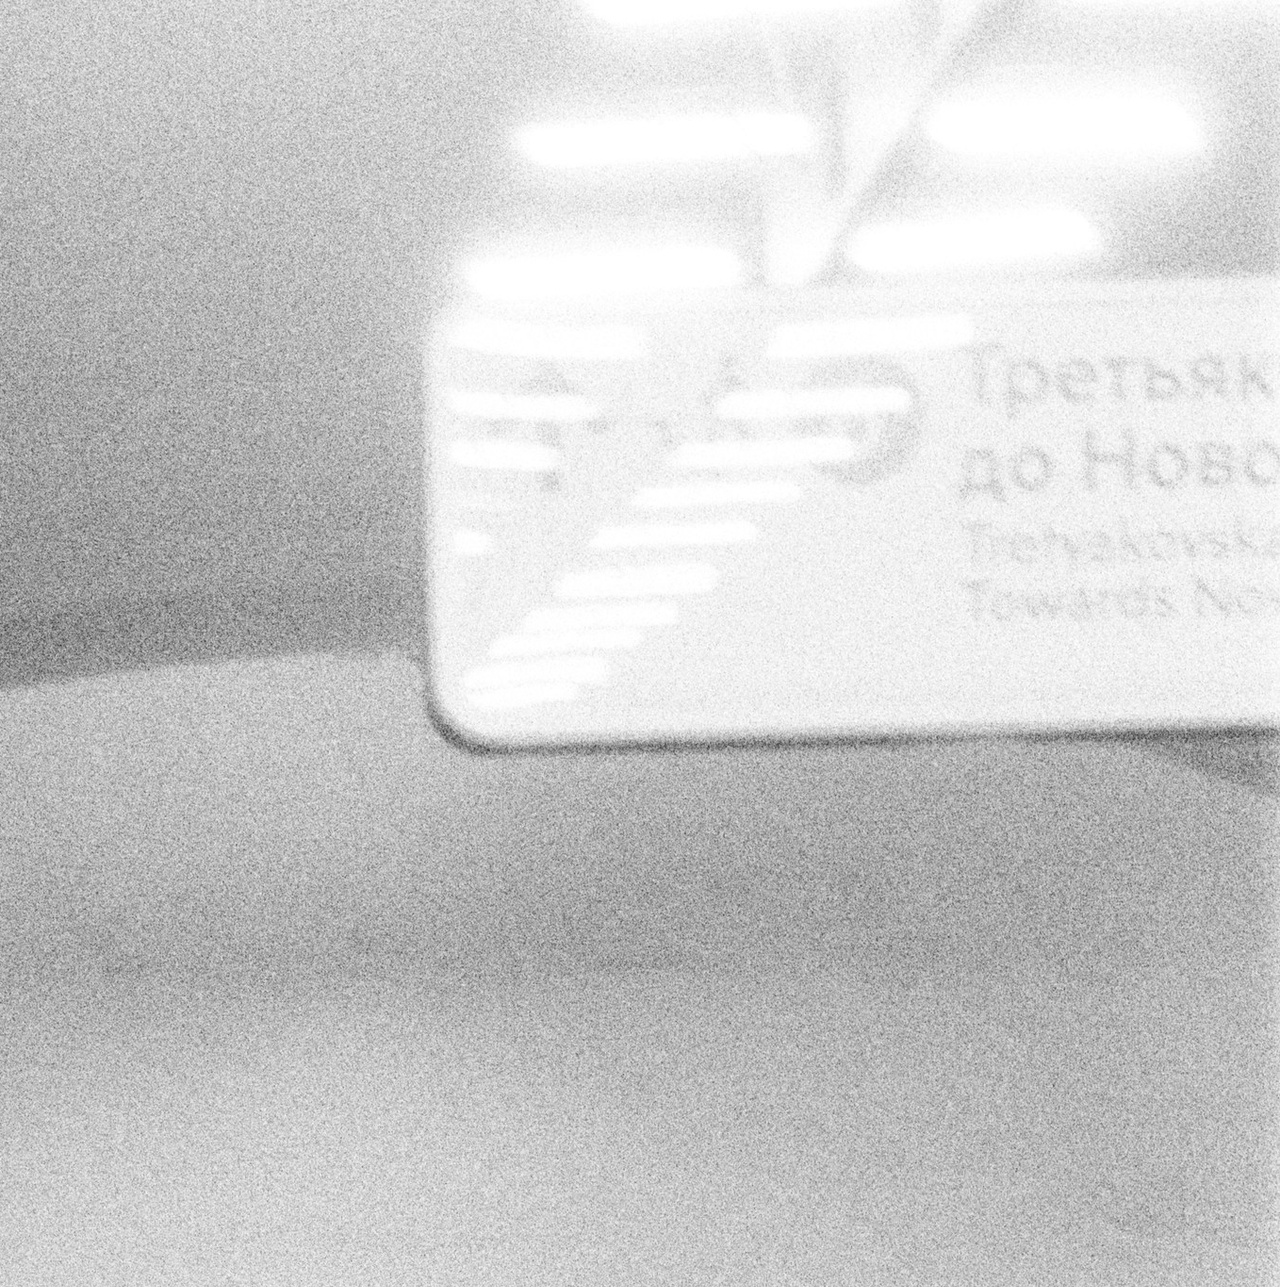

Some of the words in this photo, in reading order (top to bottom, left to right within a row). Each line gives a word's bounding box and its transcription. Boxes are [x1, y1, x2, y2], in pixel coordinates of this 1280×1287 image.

[963, 343, 1274, 418] Третьяк
[959, 442, 1053, 503] до
[1083, 427, 1280, 492] Ново
[959, 576, 1176, 622] Towards
